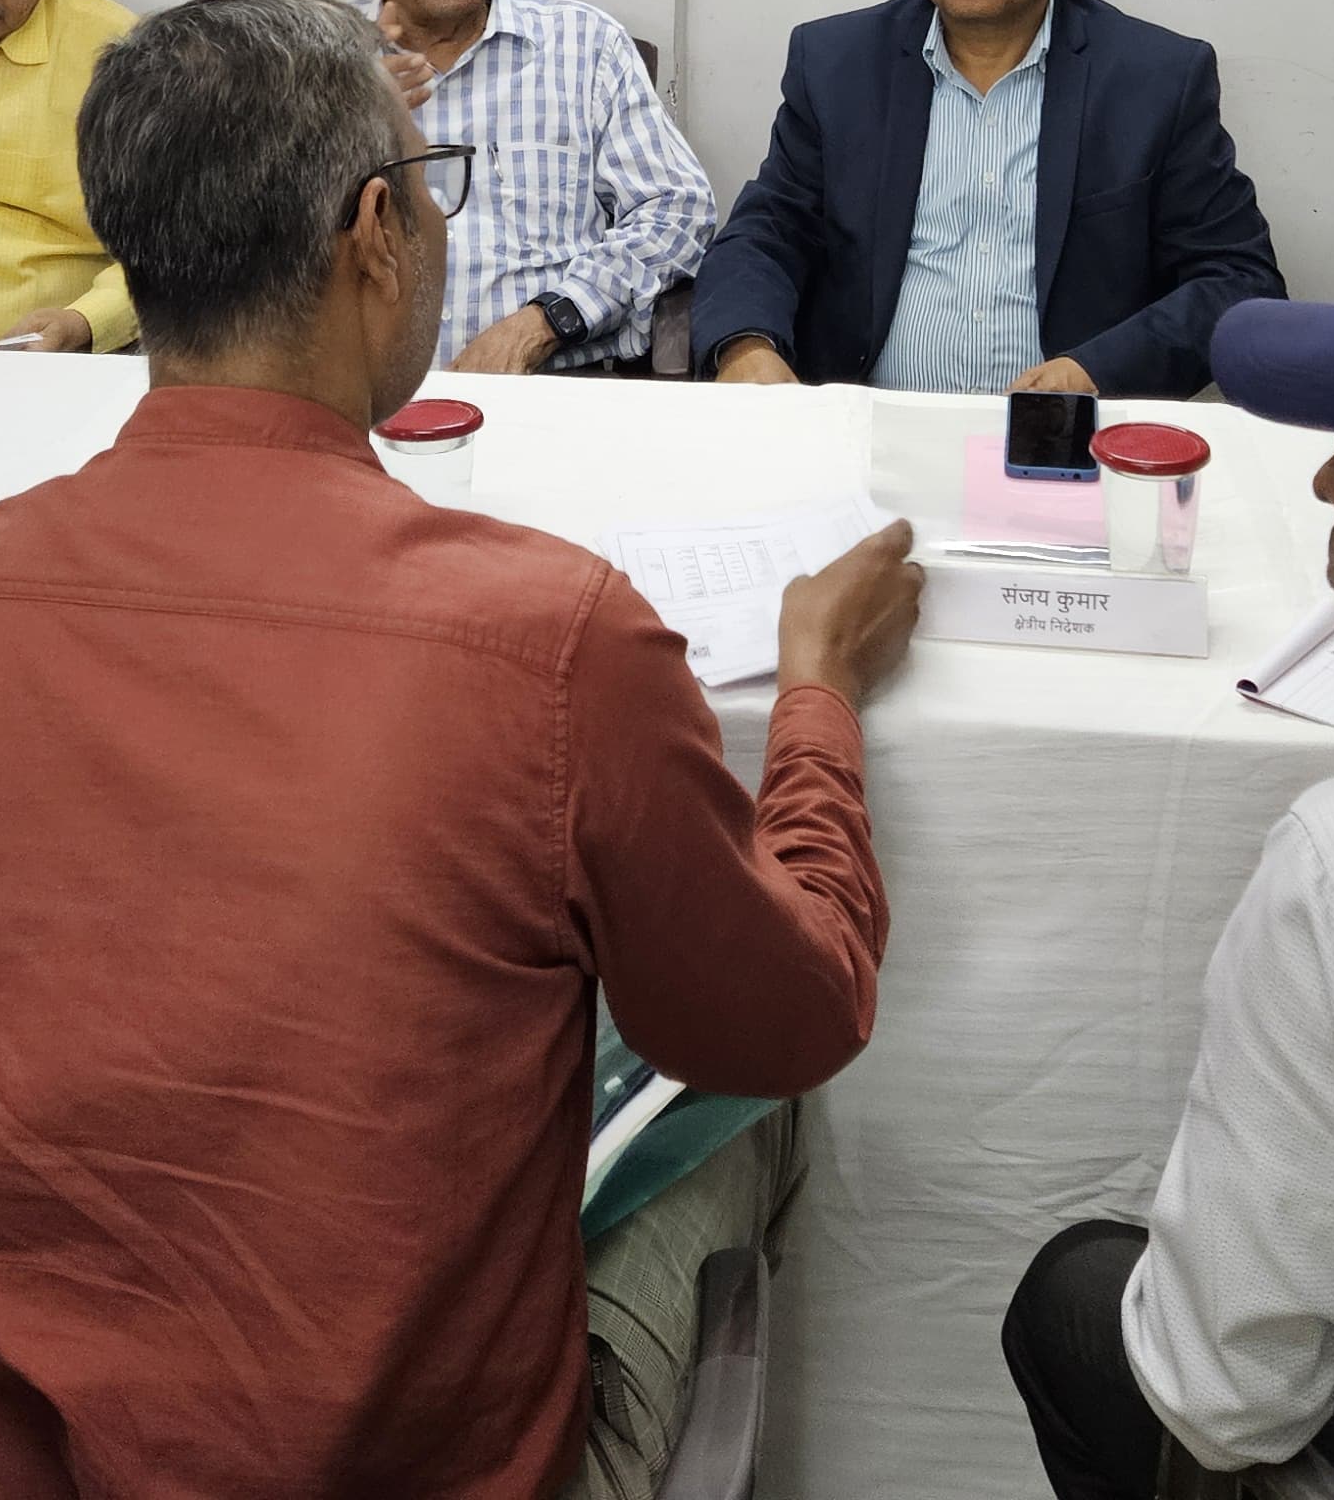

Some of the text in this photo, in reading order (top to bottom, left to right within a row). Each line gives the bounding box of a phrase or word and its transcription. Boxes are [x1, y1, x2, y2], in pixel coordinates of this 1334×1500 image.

[1001, 583, 1111, 613] संजय कुमार
[1014, 614, 1095, 634] क्षेत्रीय निदेशक
